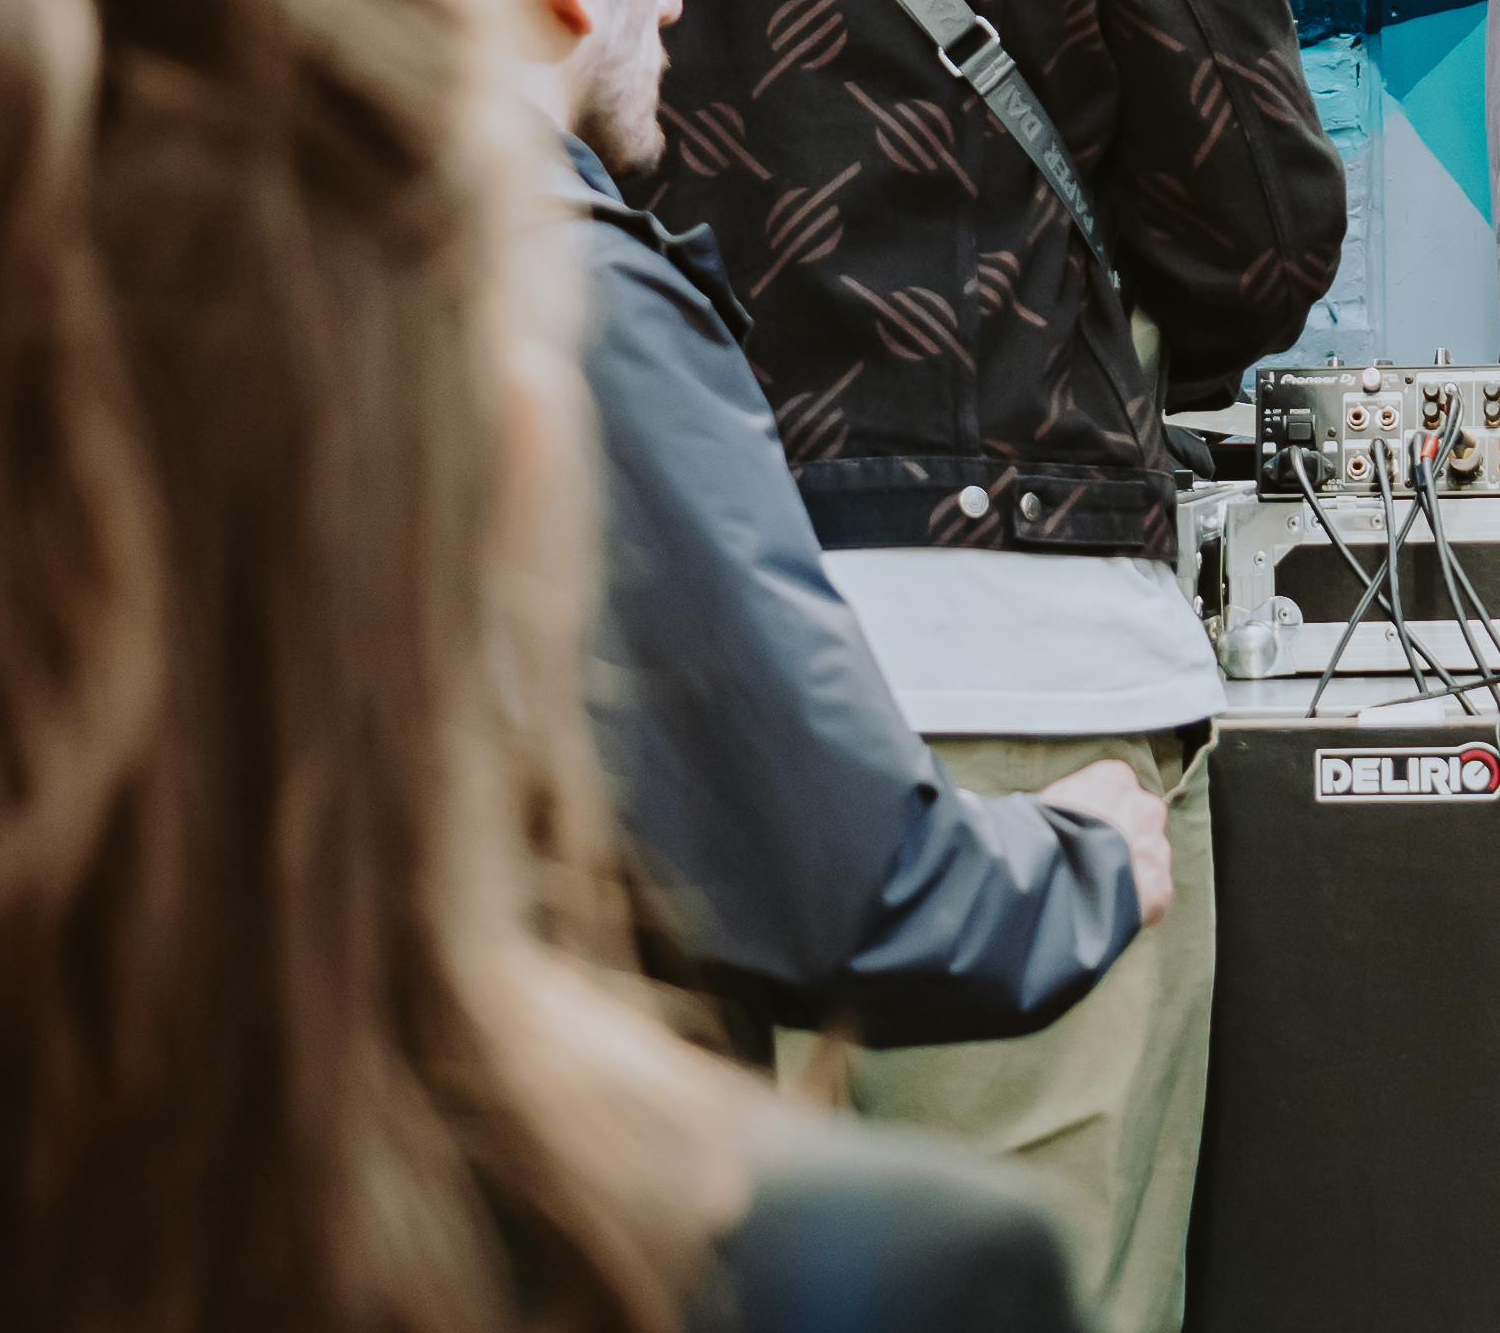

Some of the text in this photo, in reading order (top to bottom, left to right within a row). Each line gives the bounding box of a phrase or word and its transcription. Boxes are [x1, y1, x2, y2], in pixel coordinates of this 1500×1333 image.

[991, 77, 1047, 142] DAI
[1280, 373, 1339, 385] Pioneer
[1321, 748, 1500, 795] DELIRIO
